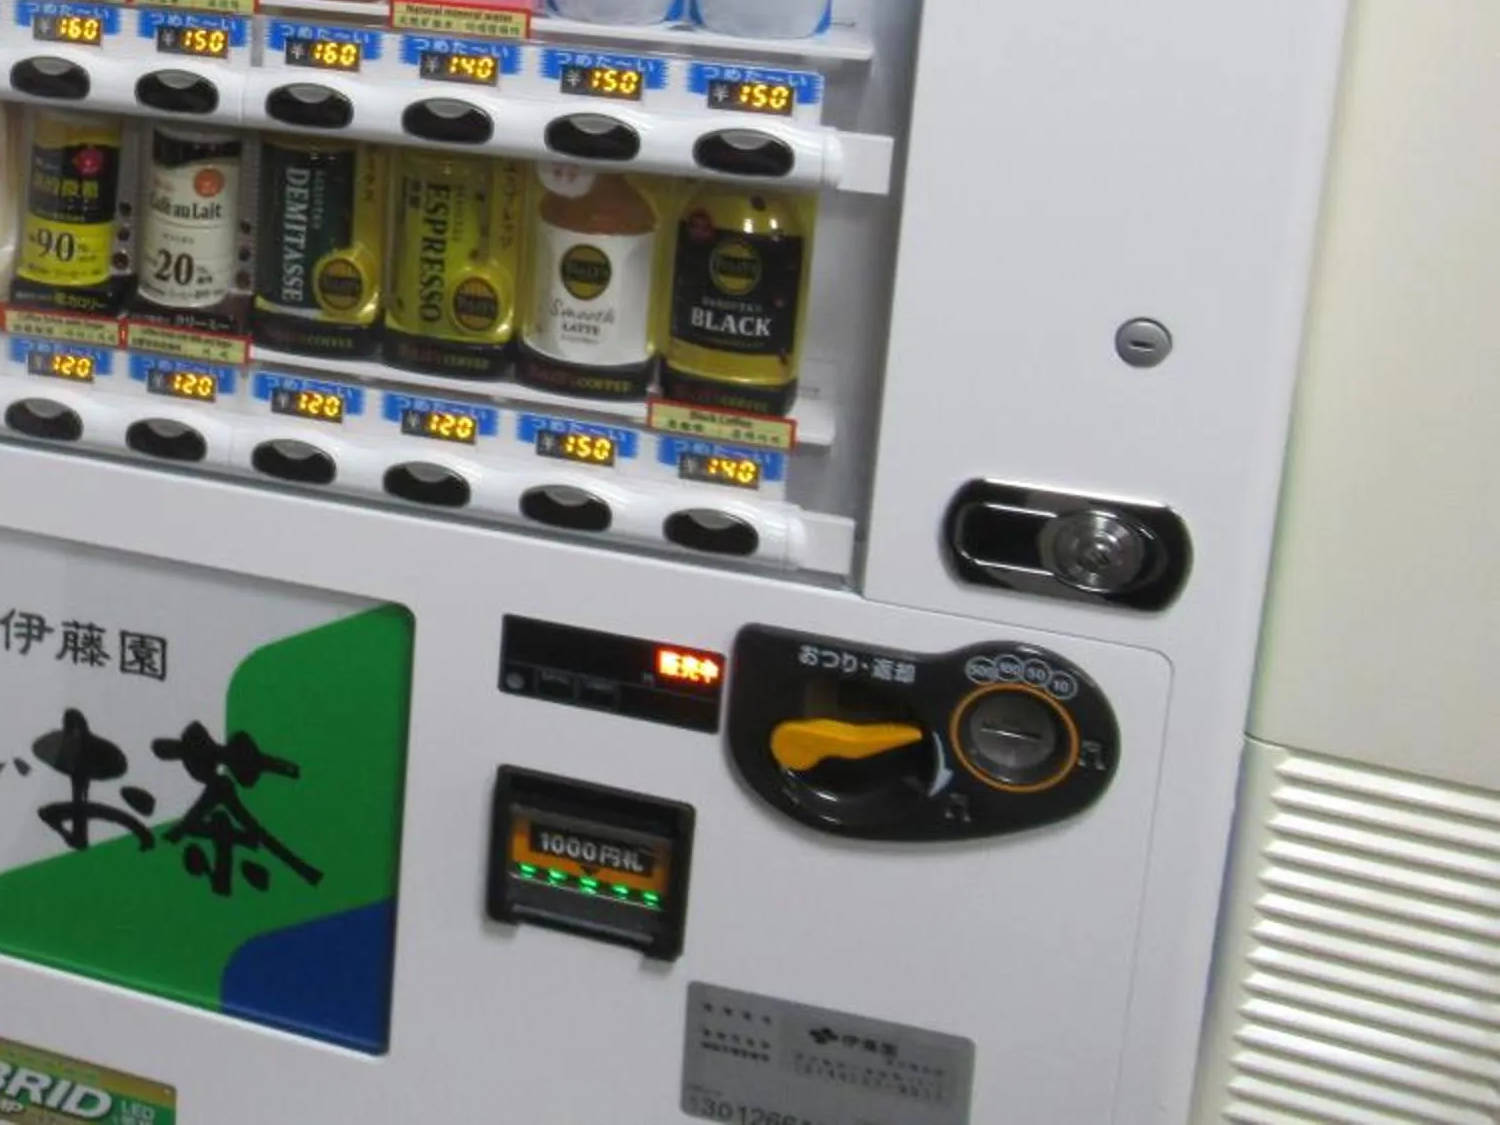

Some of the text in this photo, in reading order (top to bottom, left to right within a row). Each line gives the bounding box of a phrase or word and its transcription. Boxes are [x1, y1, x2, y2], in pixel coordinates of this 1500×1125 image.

[192, 201, 222, 219] Lait
[35, 230, 76, 264] 90
[282, 166, 311, 303] DEMITASSE
[420, 182, 452, 323] ESPRESSO
[154, 249, 195, 287] 20
[690, 306, 772, 338] BLACK
